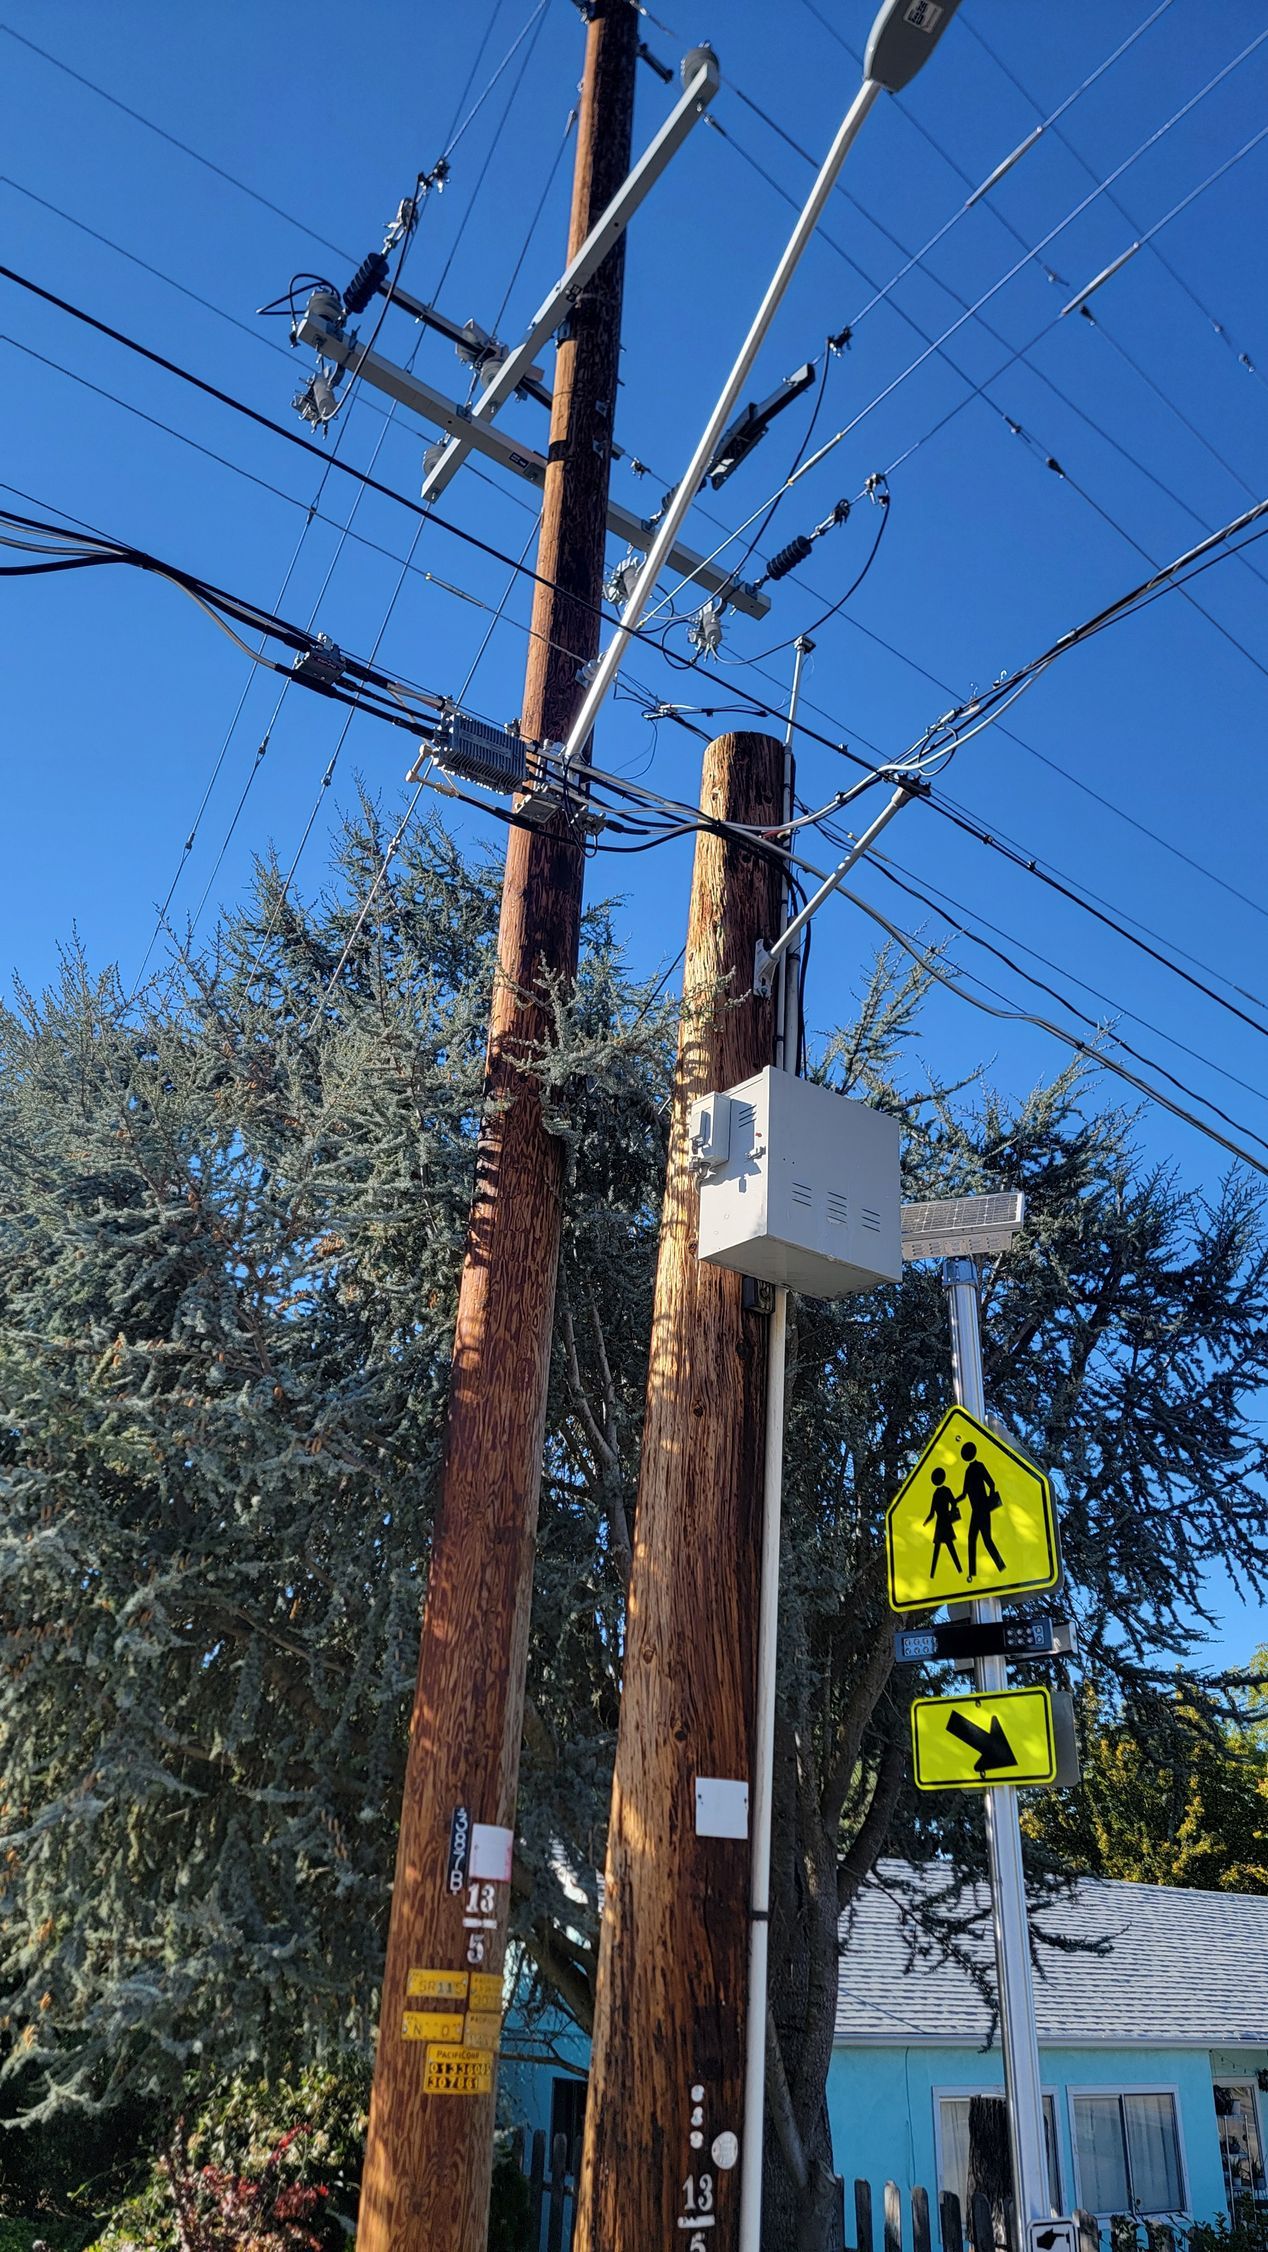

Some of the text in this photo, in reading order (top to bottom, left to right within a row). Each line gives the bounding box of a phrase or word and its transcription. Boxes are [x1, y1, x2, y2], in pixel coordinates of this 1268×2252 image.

[450, 1812, 468, 1891] 387B
[466, 1883, 495, 1913] 13
[467, 1933, 485, 1964] 5
[682, 2173, 713, 2211] 13
